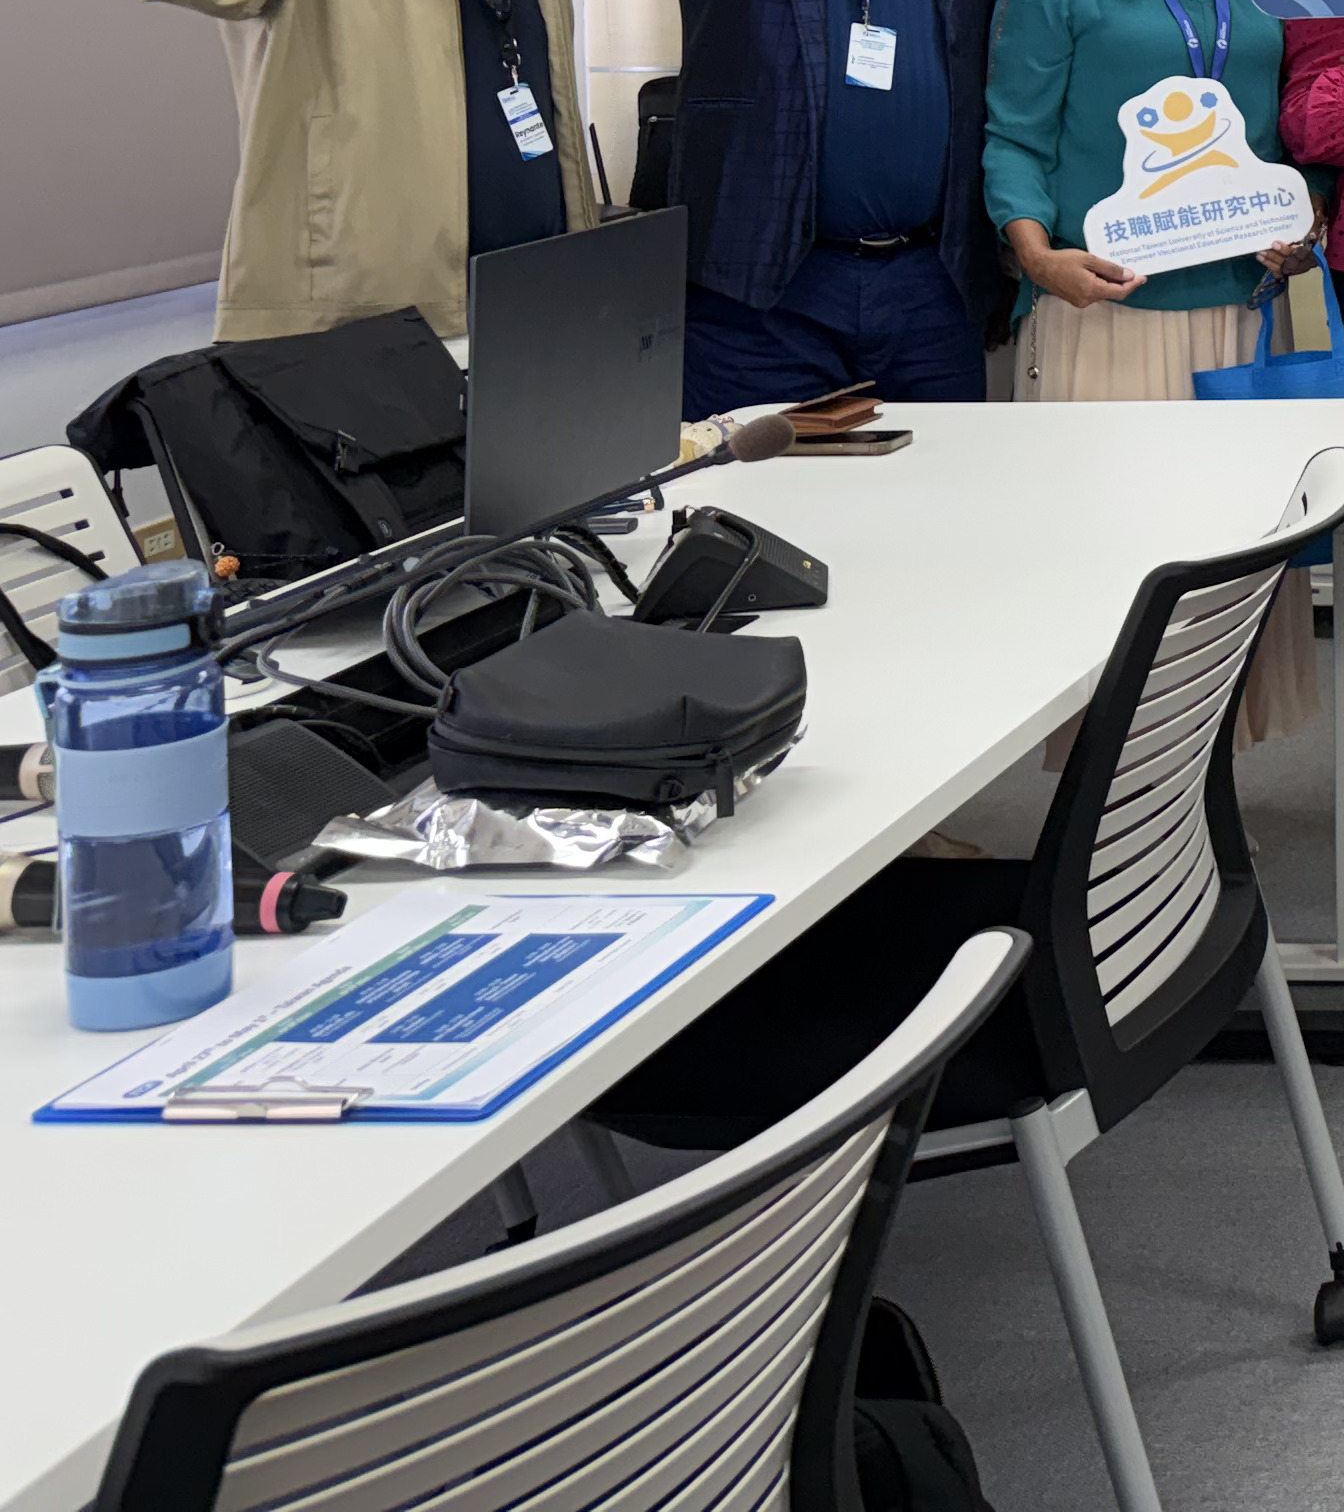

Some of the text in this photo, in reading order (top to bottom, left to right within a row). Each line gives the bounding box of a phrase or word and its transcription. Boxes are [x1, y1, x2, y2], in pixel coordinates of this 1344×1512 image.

[1103, 186, 1297, 245] 技職賦能研究中心
[1168, 231, 1206, 249] University
[1206, 230, 1215, 238] of
[1215, 224, 1244, 237] Science
[1244, 219, 1259, 230] and
[1259, 212, 1300, 228] Technology
[1121, 223, 1293, 265] Empower Vocational Education Research Center
